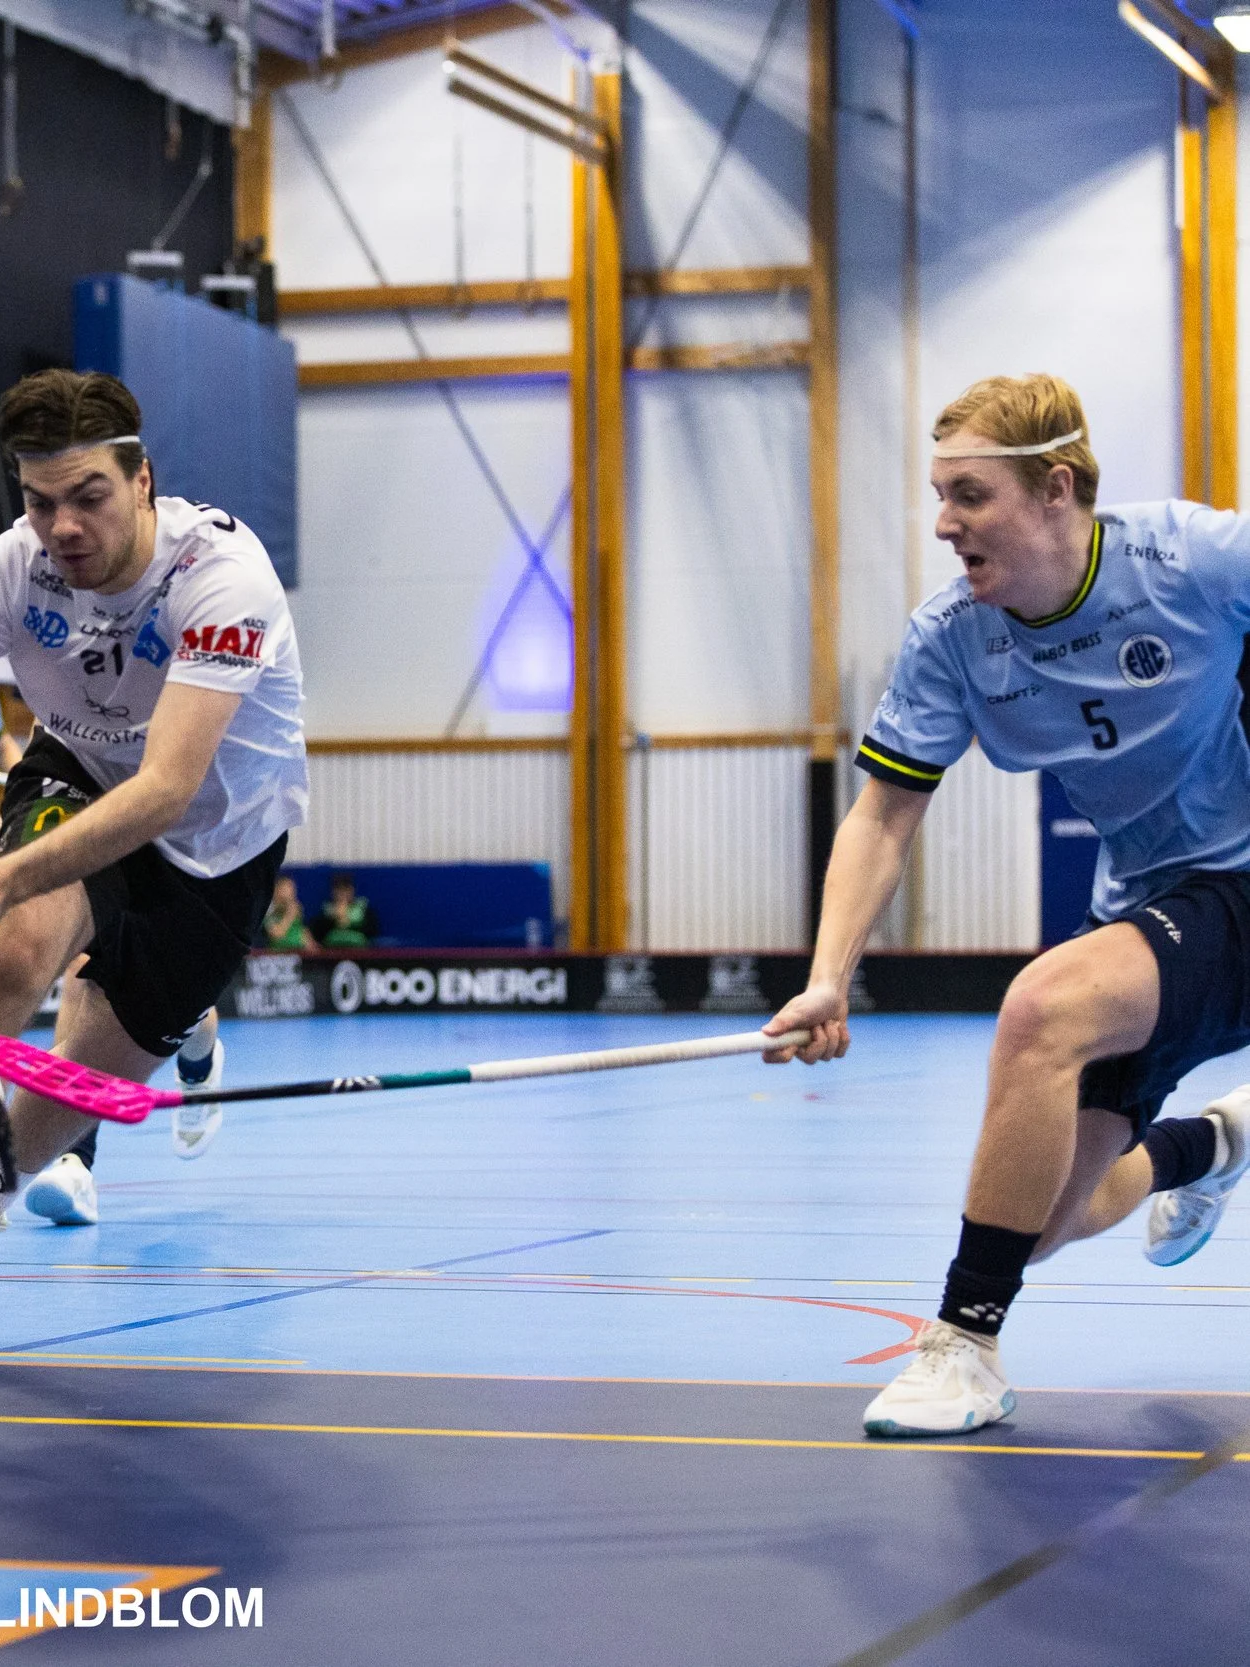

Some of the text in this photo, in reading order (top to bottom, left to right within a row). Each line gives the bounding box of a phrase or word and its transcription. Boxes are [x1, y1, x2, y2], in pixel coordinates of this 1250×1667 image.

[181, 624, 265, 658] MAXI
[80, 642, 124, 676] 21
[987, 686, 1029, 705] CRAFT
[1080, 700, 1119, 751] 5
[441, 967, 567, 1003] ENERGI
